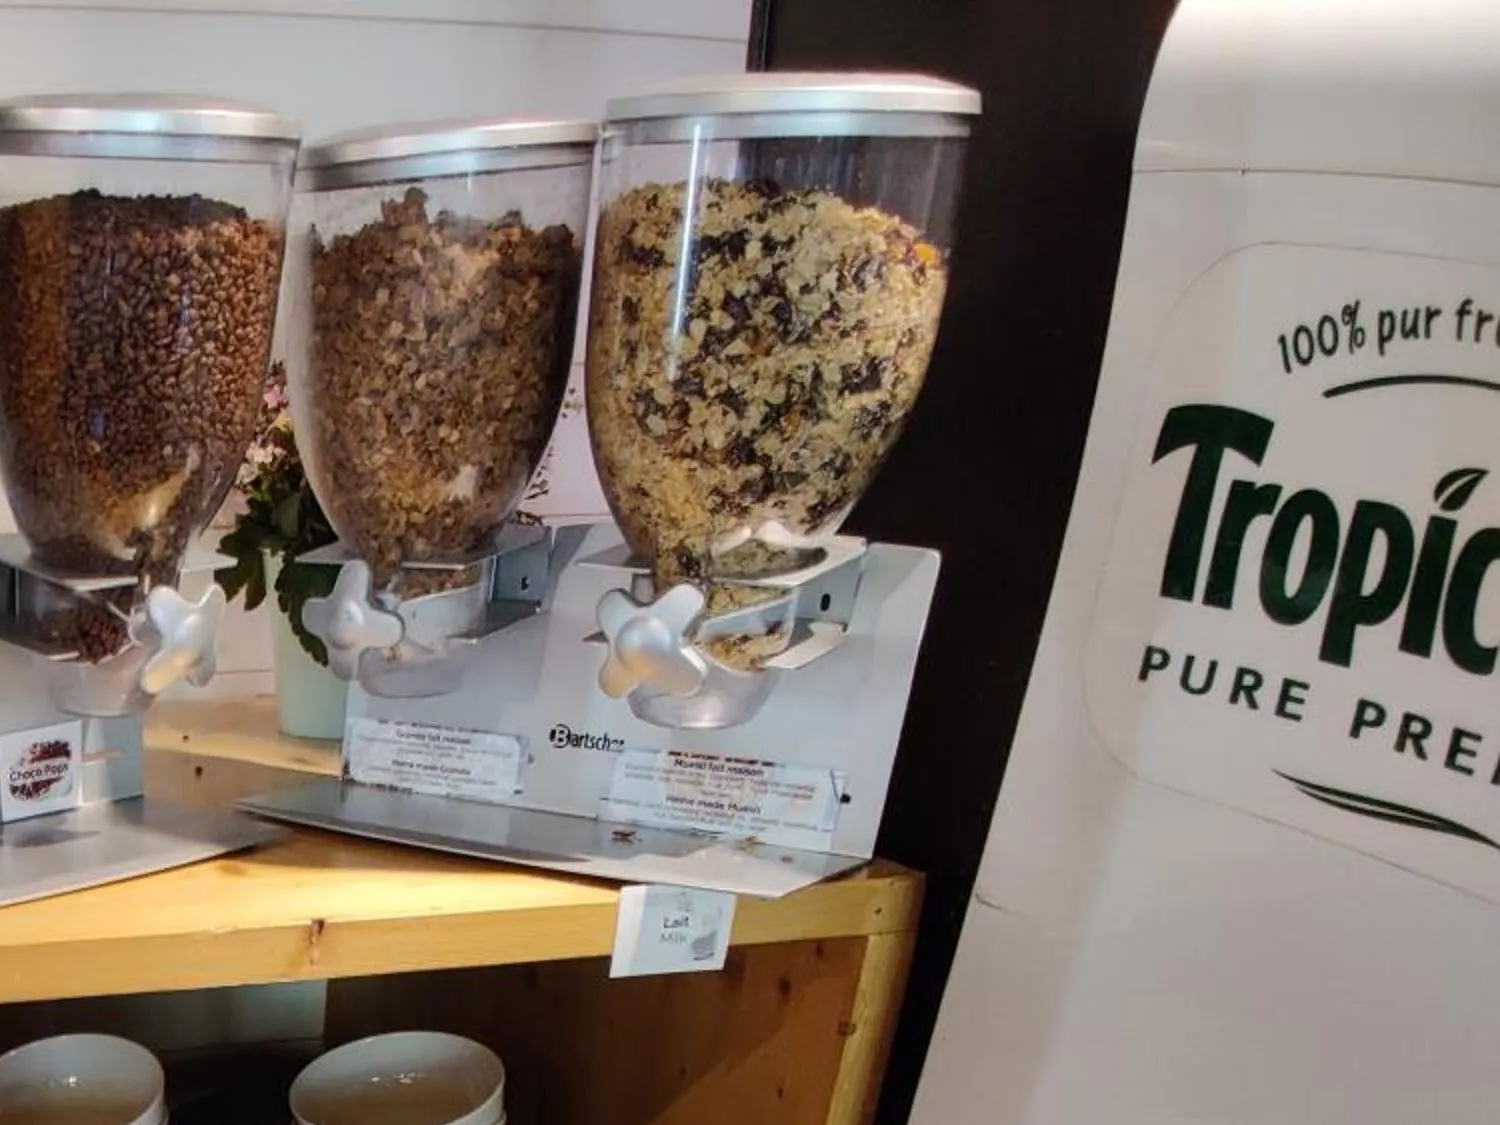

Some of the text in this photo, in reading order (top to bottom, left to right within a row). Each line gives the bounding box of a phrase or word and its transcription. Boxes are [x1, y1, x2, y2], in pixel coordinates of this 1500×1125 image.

[1277, 297, 1500, 374] 100% pur fr
[1151, 402, 1500, 677] Tropic
[1137, 645, 1500, 786] PURE PRE
[662, 915, 690, 930] Lait
